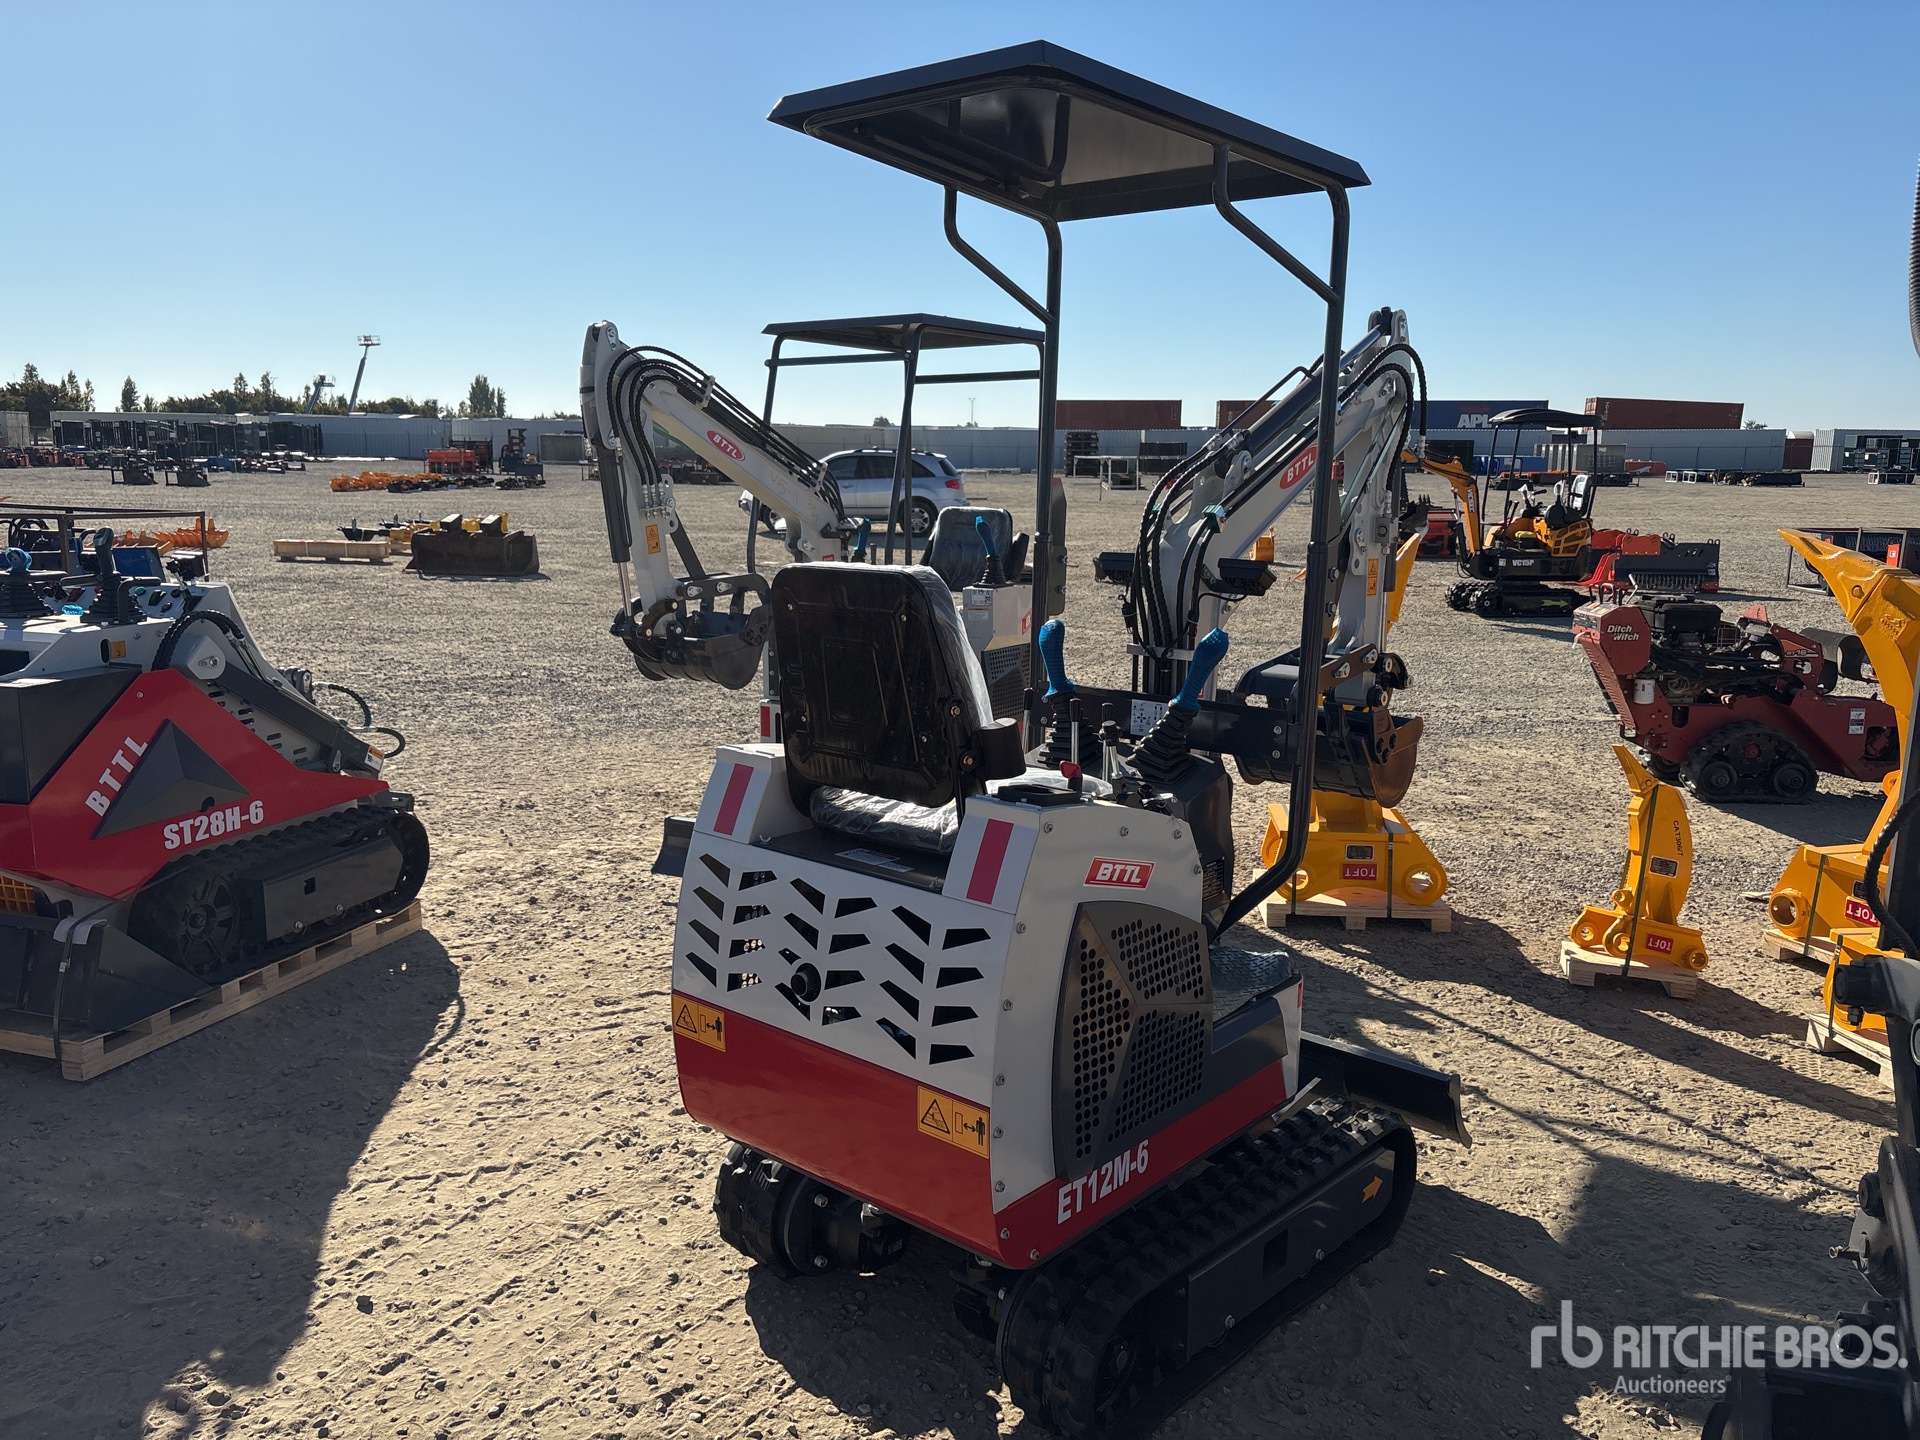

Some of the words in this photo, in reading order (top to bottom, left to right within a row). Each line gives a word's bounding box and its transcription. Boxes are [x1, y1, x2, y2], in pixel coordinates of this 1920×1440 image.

[1457, 413, 1492, 428] APL
[713, 434, 737, 458] BTTL
[1286, 453, 1314, 483] BTTL
[1512, 559, 1535, 567] VC15P
[1607, 625, 1632, 633] Ditch
[1613, 633, 1640, 641] Witch
[85, 736, 148, 817] BTTL
[163, 800, 264, 850] ST28H-6
[1096, 862, 1142, 884] BTTL
[1344, 867, 1376, 877] TOFT
[1846, 903, 1877, 923] TOFT
[1648, 937, 1671, 951] TOFT
[1057, 1139, 1149, 1225] ET12M-6
